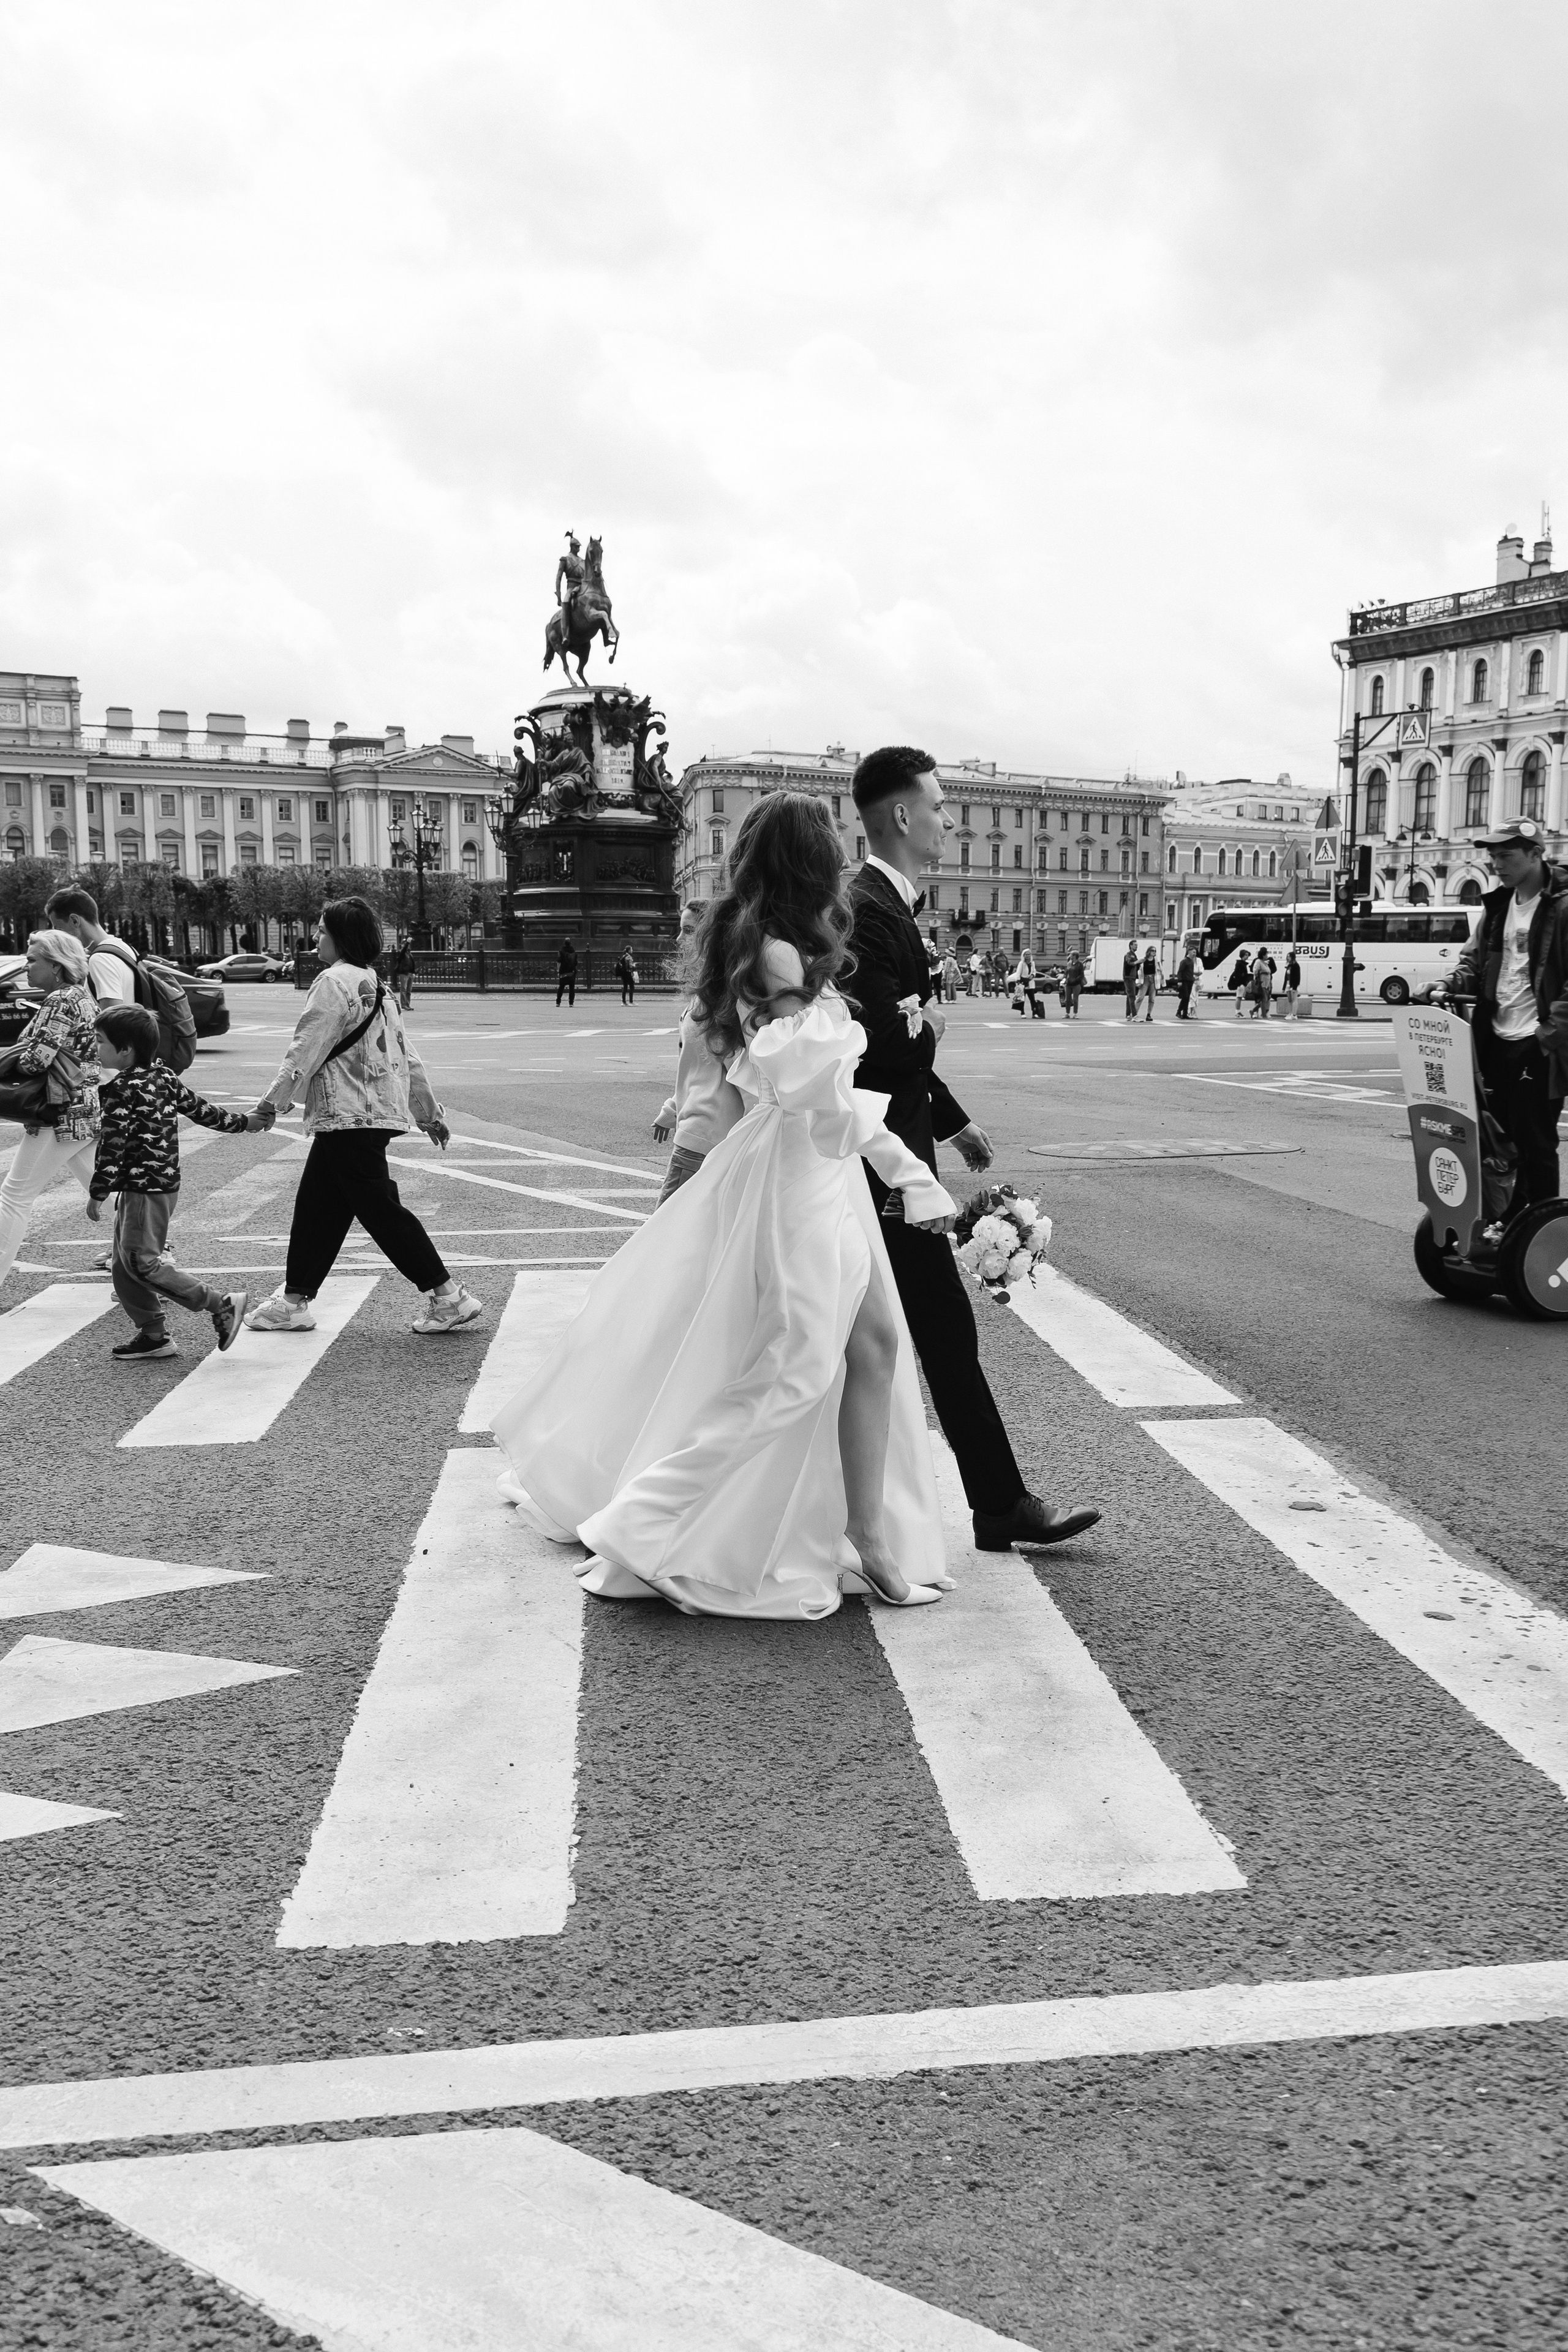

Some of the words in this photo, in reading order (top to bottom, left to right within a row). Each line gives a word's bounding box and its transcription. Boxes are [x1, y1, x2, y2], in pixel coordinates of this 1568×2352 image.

[1408, 1017, 1420, 1029] СО
[1423, 1020, 1450, 1033] МНОЙ
[1414, 1033, 1453, 1046] ПЕТЕРБУРГЕ
[1418, 1044, 1446, 1059] ЯСНО!
[1435, 1157, 1457, 1172] САНКТ
